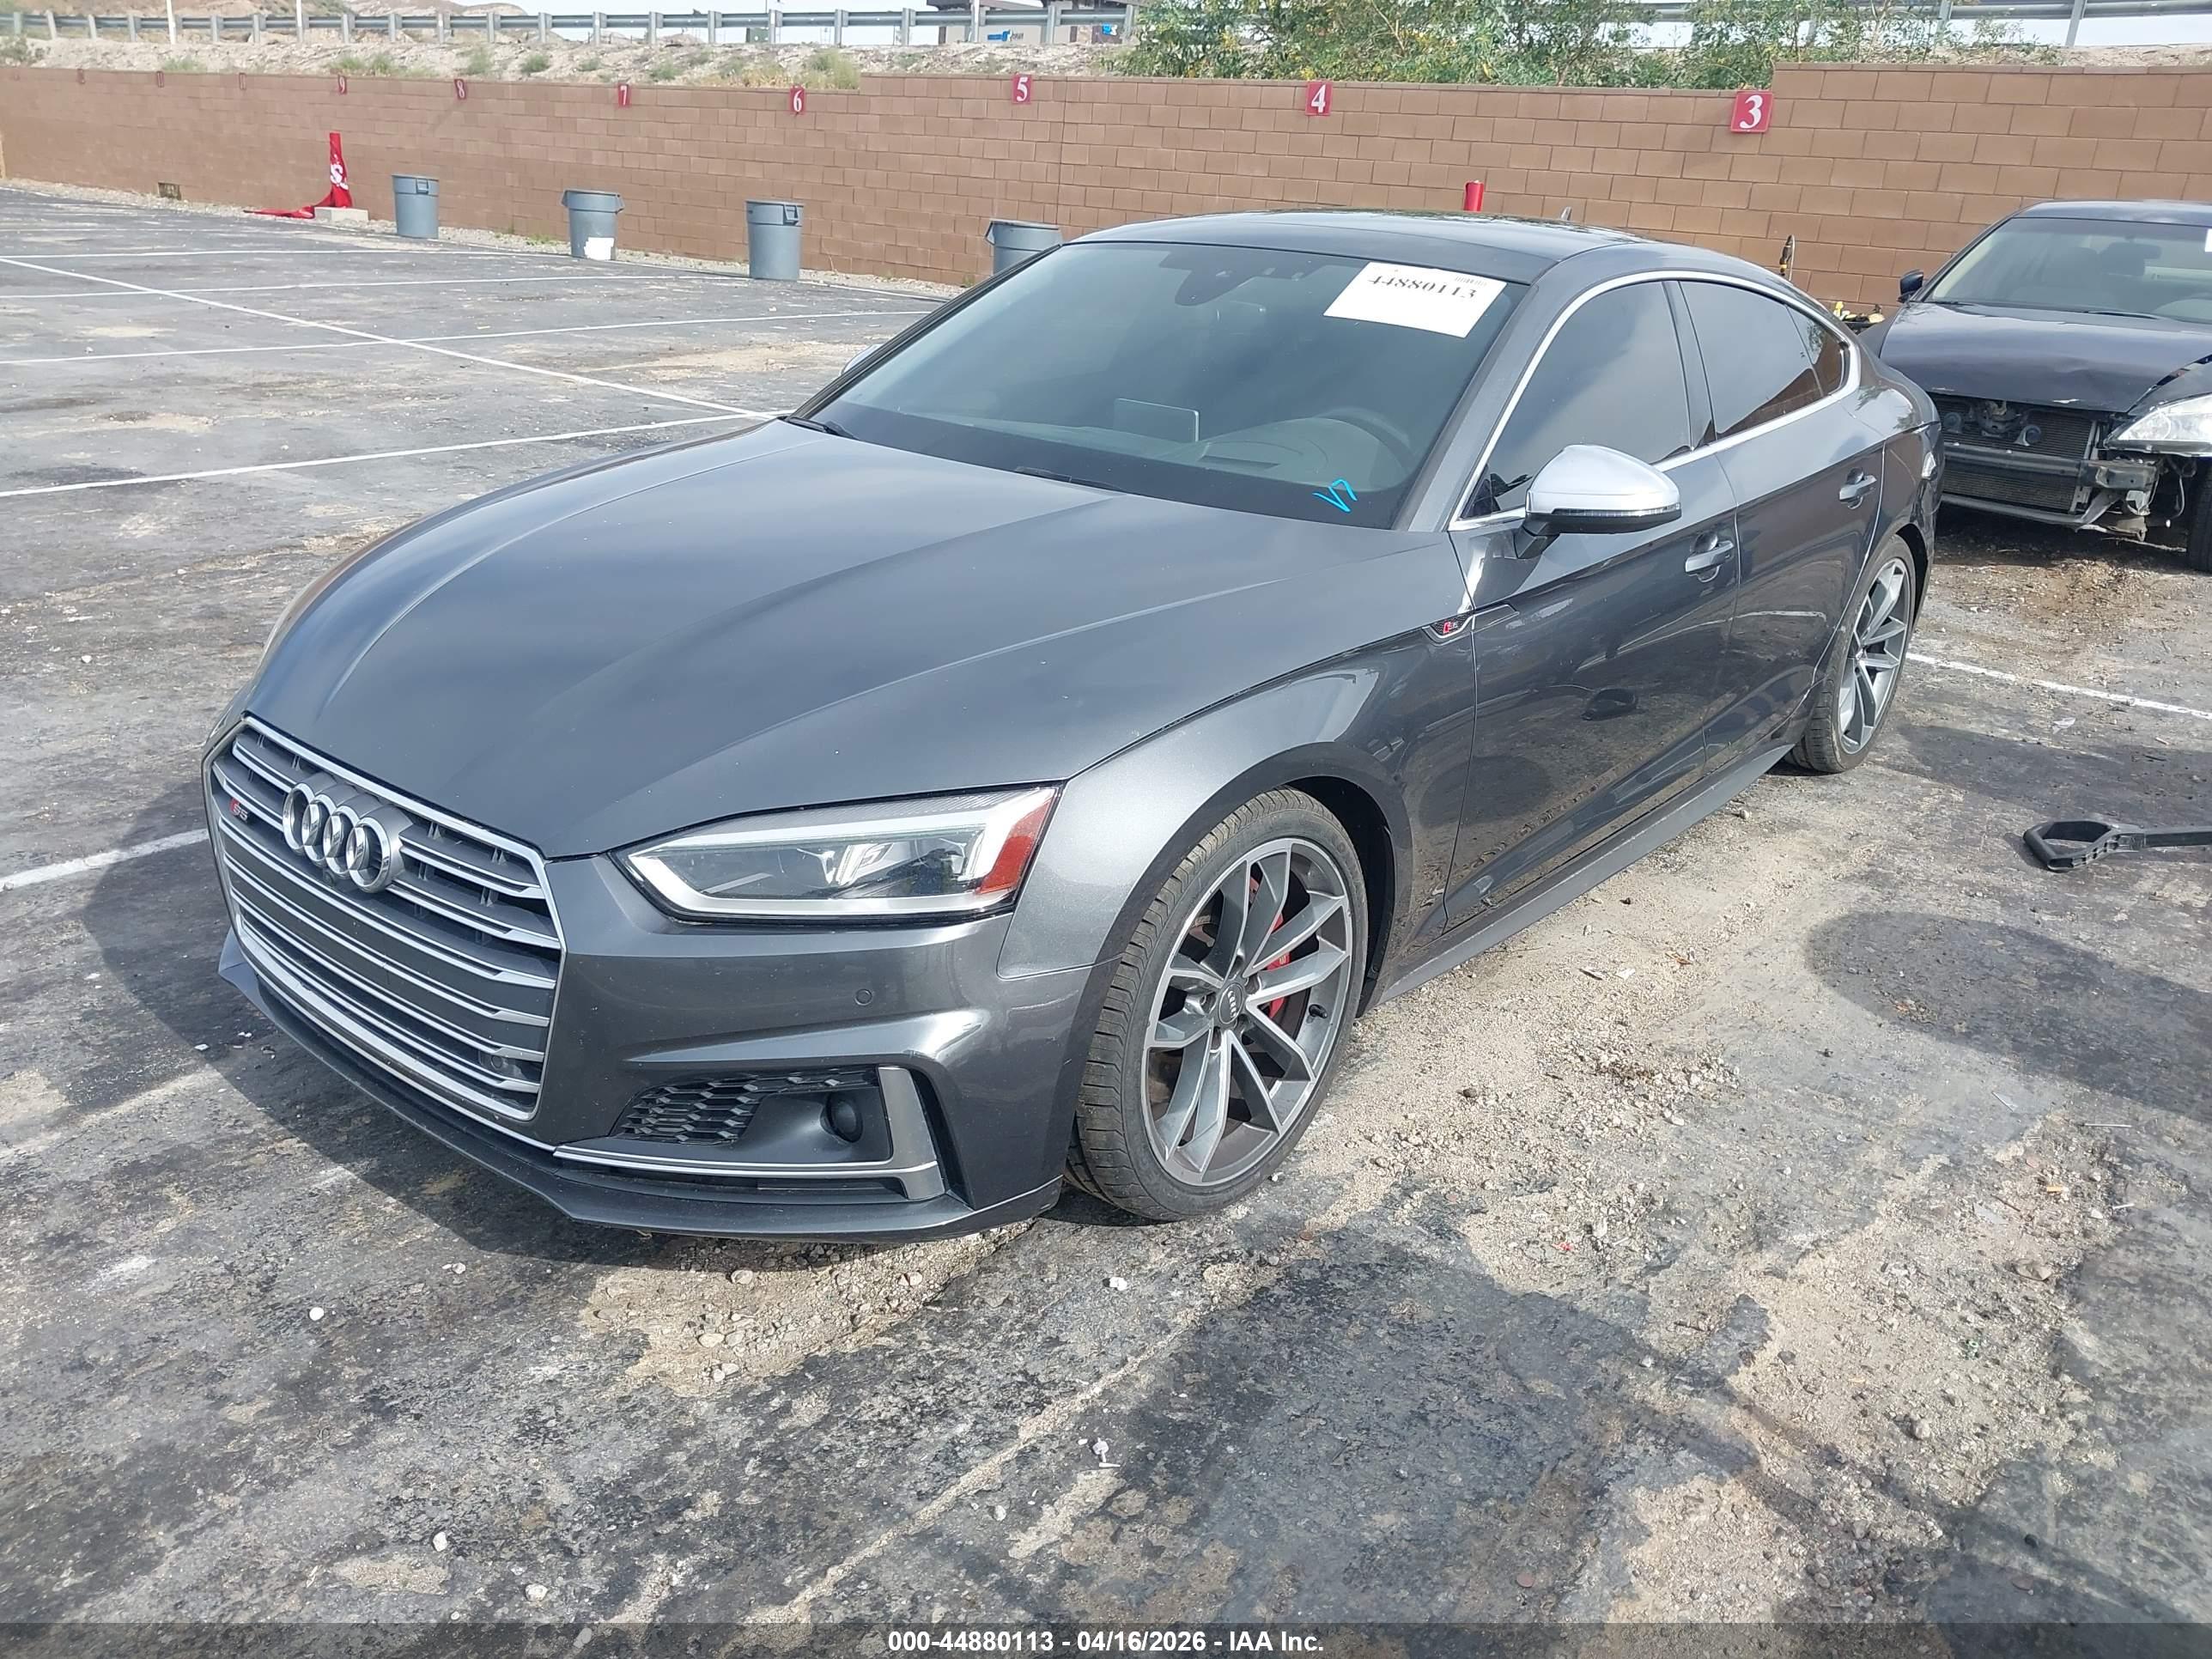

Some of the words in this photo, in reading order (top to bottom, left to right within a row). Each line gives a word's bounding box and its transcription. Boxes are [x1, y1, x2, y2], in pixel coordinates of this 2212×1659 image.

[457, 80, 465, 98] 8
[620, 85, 628, 106] 7
[793, 89, 802, 112] 6
[1016, 76, 1028, 102] 5
[1311, 84, 1326, 112] 4
[1739, 94, 1763, 129] 3
[1369, 275, 1478, 299] 44880113
